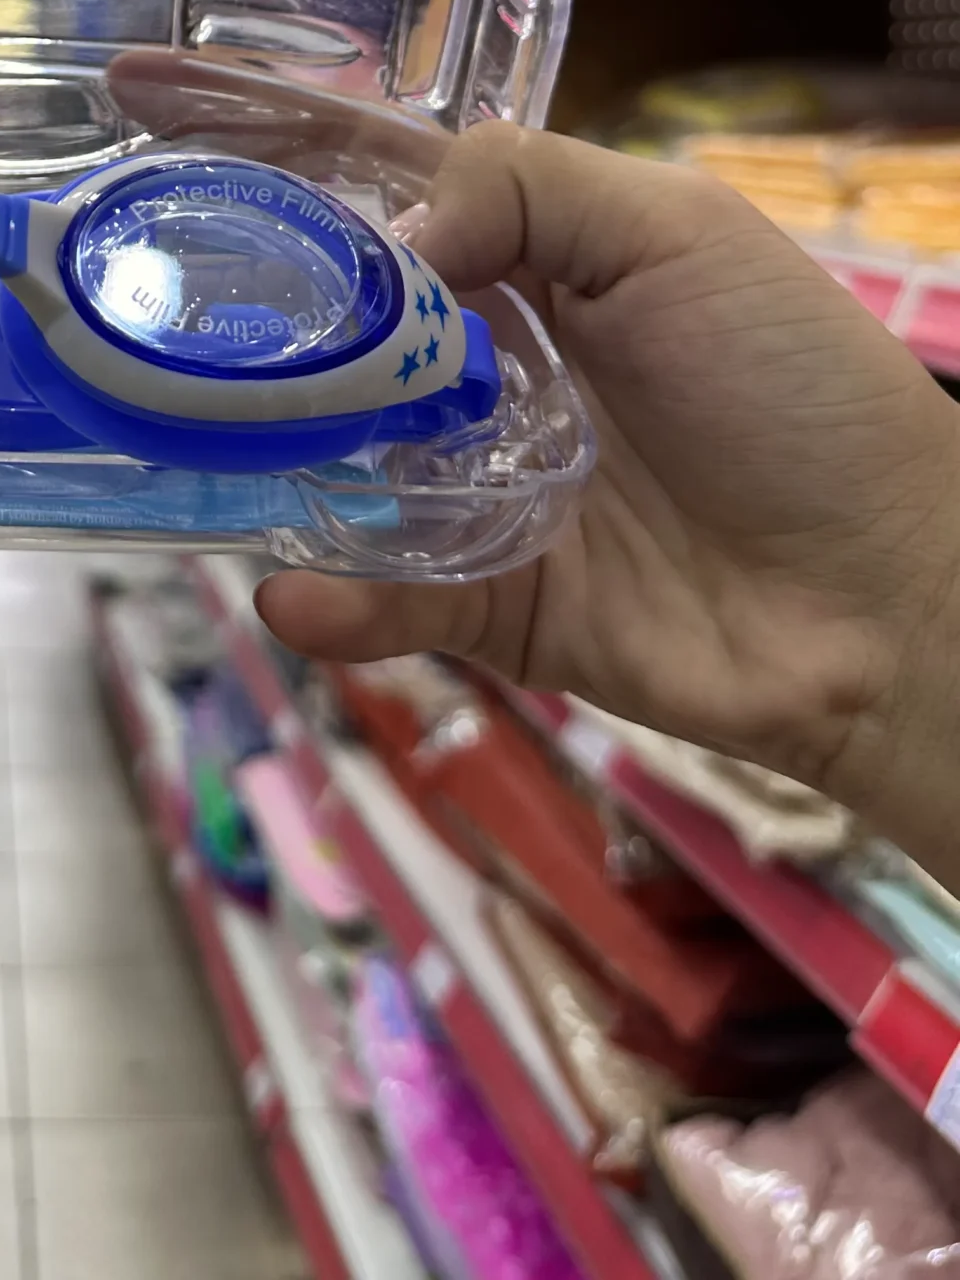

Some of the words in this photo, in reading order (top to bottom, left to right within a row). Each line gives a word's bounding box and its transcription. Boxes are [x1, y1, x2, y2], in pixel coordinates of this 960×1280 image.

[129, 179, 272, 221] Protective
[281, 187, 339, 232] Film
[198, 297, 345, 342] Protective
